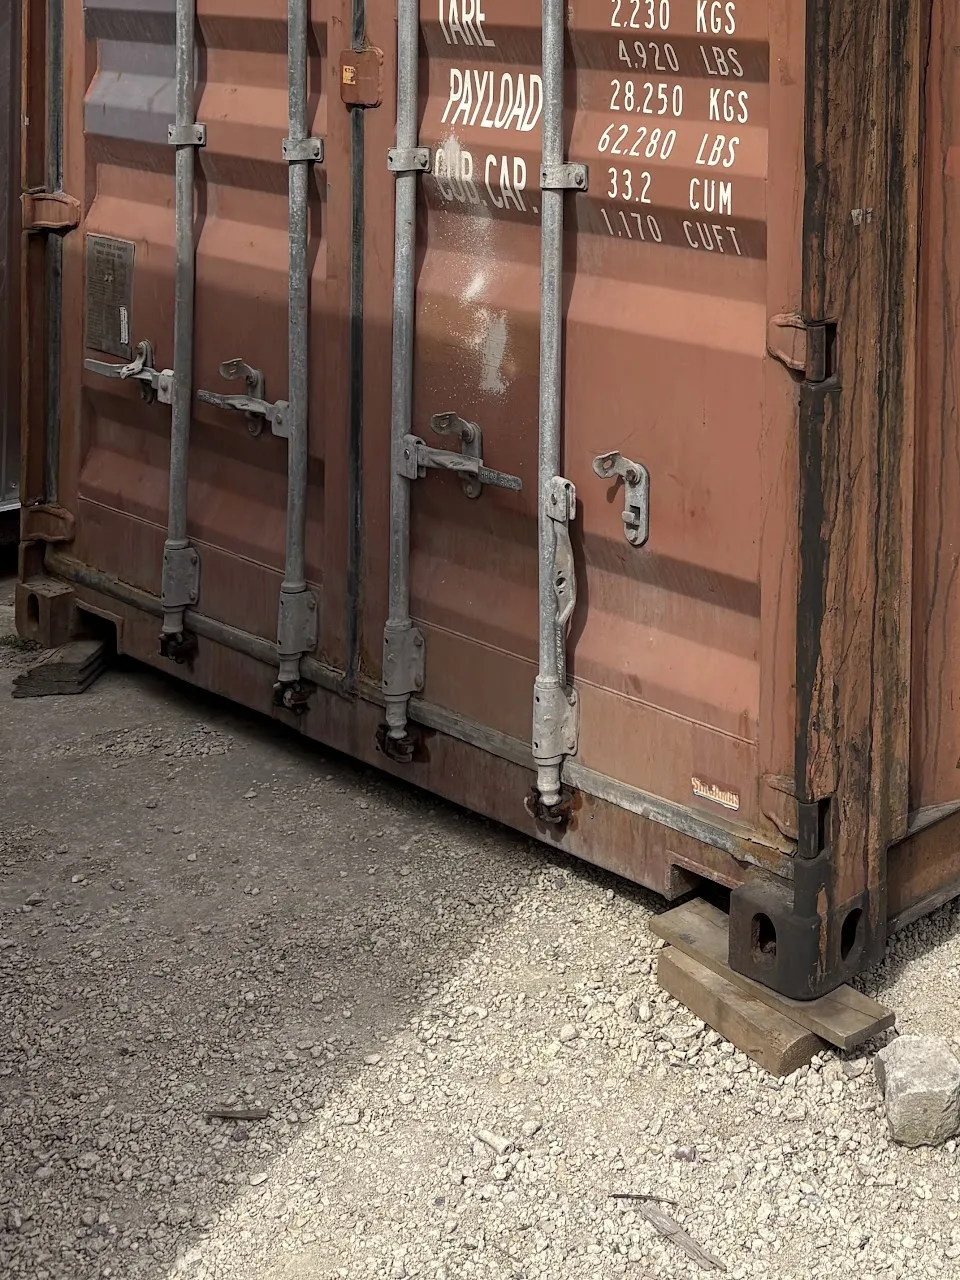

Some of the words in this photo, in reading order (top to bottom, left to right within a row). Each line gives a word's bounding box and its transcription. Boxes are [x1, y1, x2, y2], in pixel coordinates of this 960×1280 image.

[696, 0, 736, 35] KGS
[699, 45, 744, 78] LBS
[441, 68, 543, 132] PAYLOAD
[609, 79, 684, 116] 28,250
[709, 87, 749, 123] KGS
[597, 123, 677, 160] 62,280
[695, 132, 740, 168] LBS
[484, 153, 539, 214] CAP.
[607, 167, 651, 204] 33.2
[689, 177, 732, 216] CUM
[682, 220, 742, 256] CUFT
